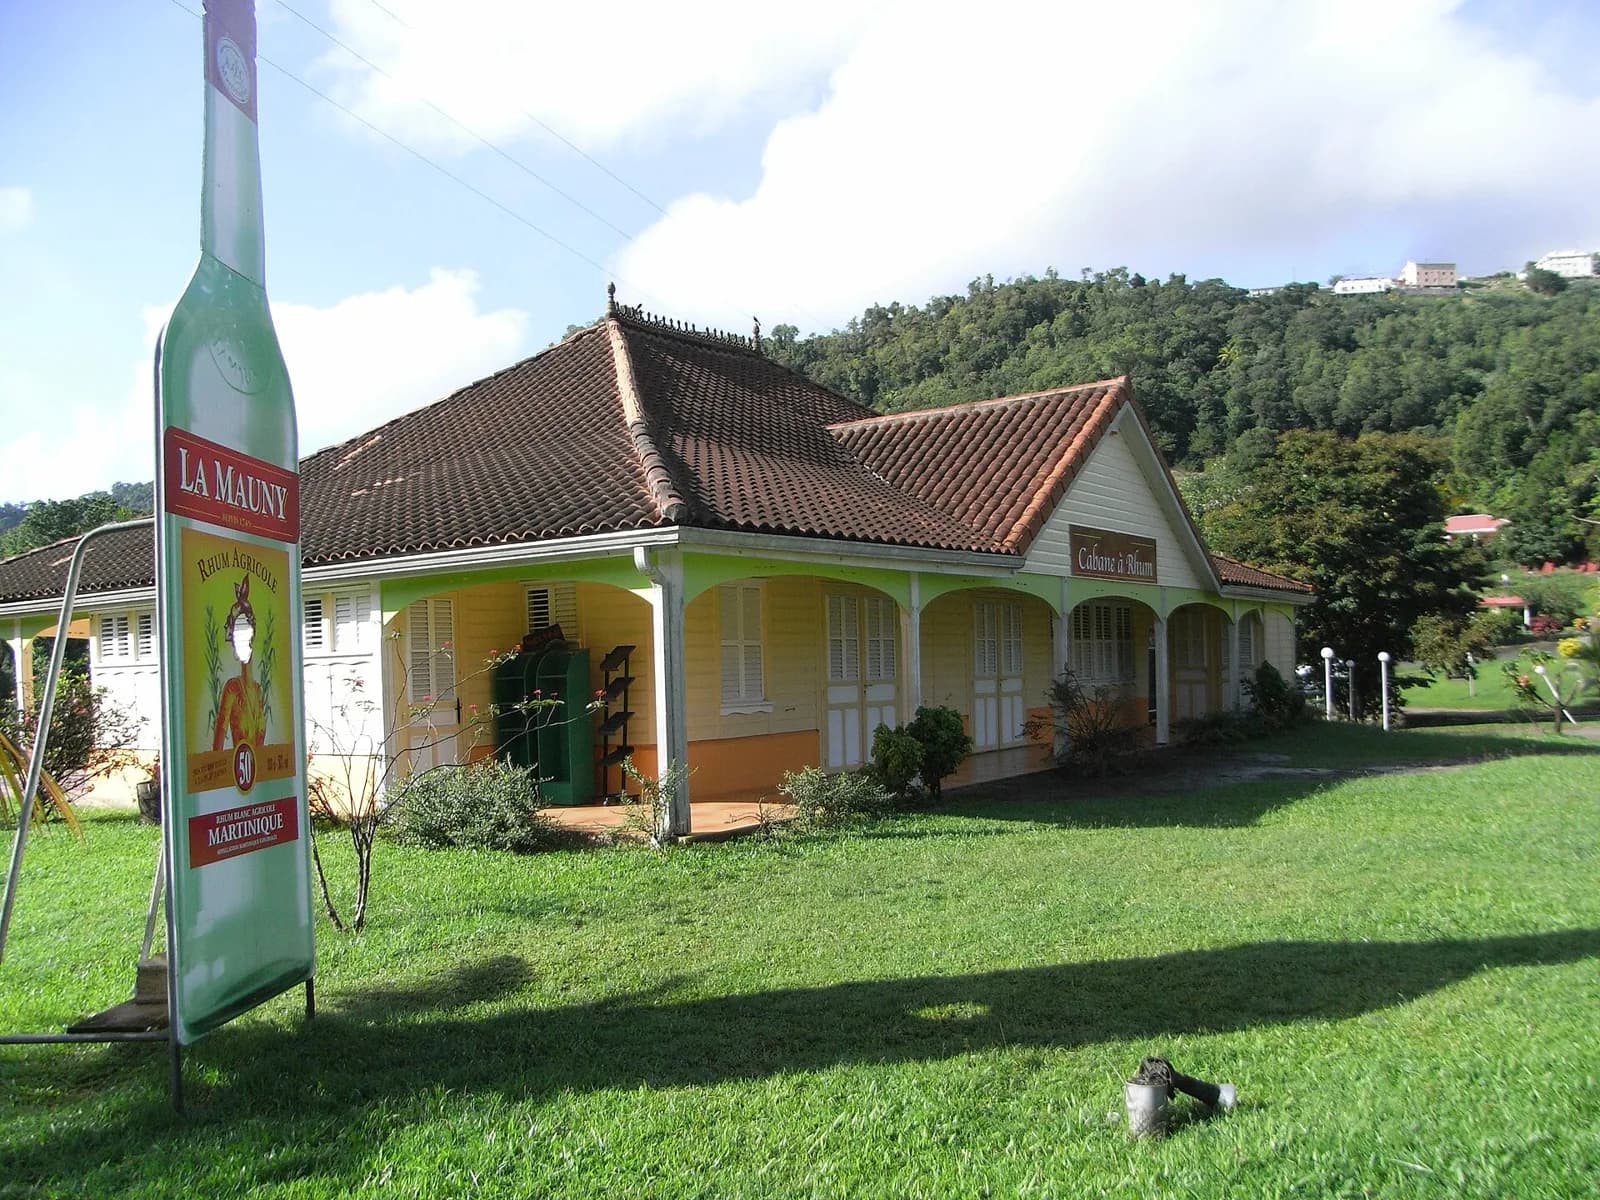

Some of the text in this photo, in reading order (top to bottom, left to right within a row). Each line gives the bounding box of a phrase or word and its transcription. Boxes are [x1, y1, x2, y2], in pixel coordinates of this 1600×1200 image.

[179, 447, 288, 520] LA MAUNY
[197, 546, 278, 594] RHUM AGRICOLE
[1078, 543, 1153, 577] Cabane à Rhum
[239, 750, 251, 785] 50
[208, 813, 284, 847] MARTINIQUE
[216, 813, 234, 824] RHUM
